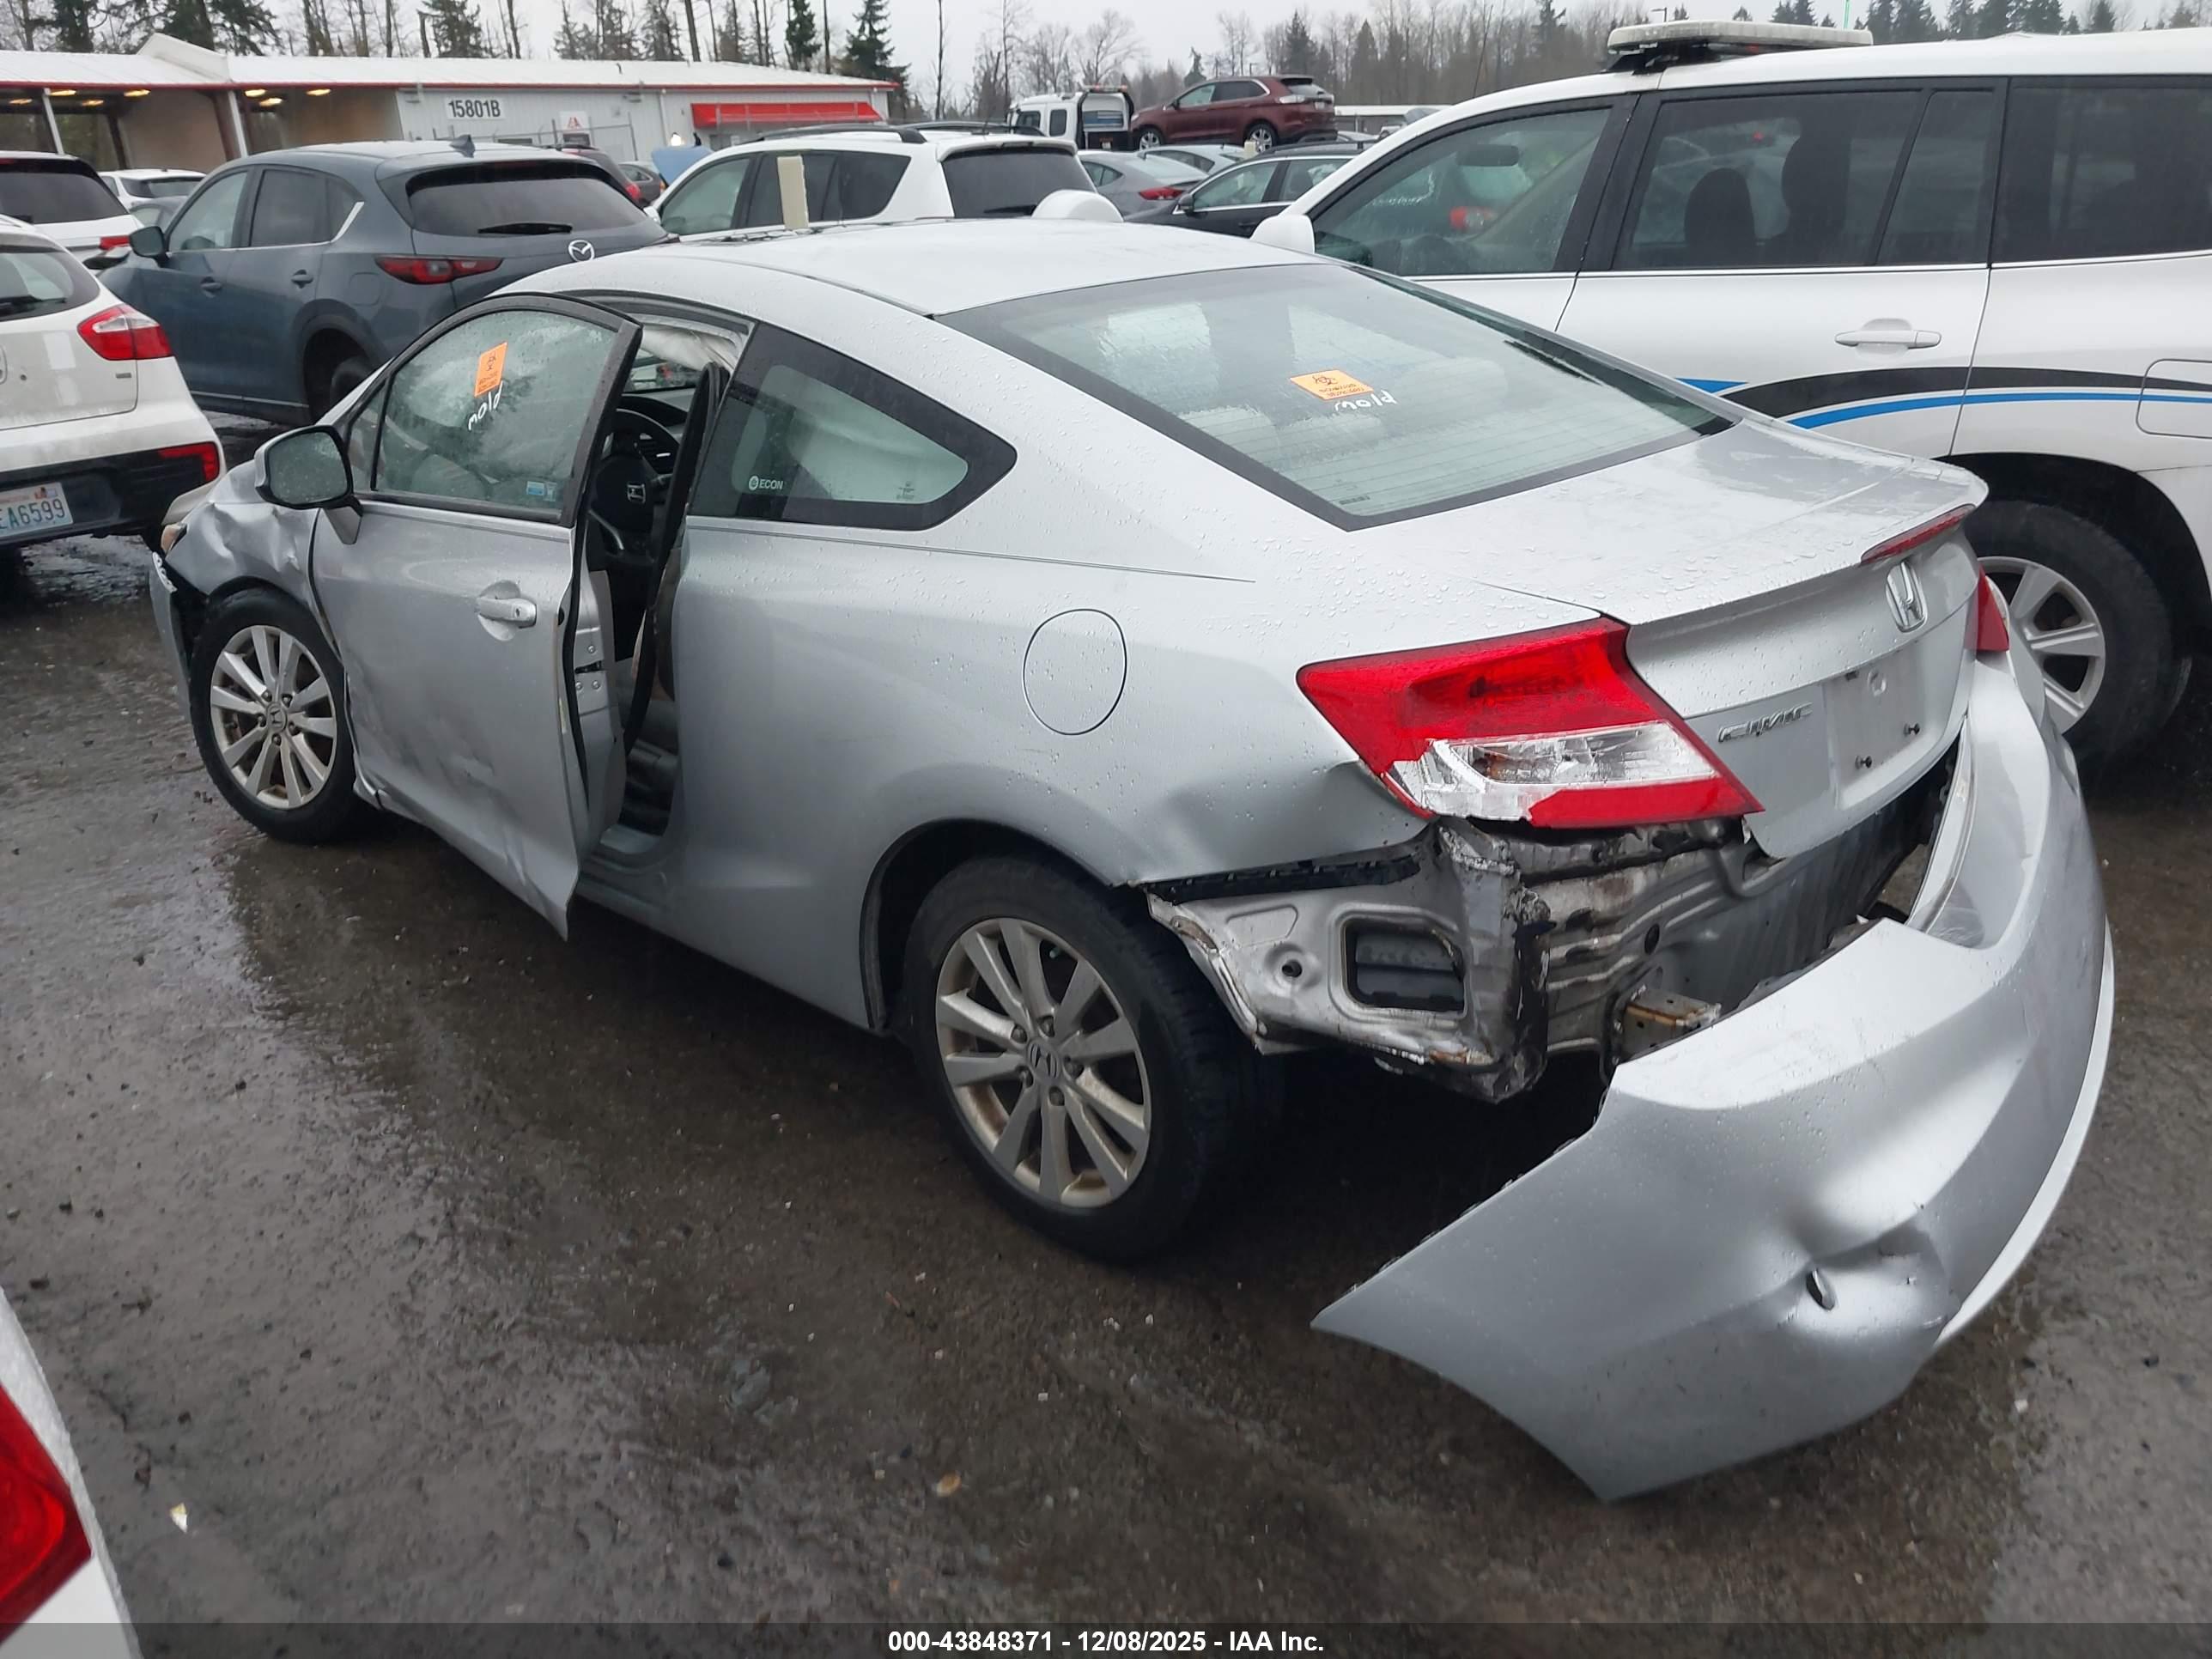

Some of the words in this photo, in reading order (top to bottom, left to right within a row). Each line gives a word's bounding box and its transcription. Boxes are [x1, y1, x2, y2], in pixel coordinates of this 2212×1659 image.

[448, 100, 501, 118] 15801B
[468, 380, 503, 431] mold
[1334, 389, 1398, 411] mold
[759, 478, 784, 489] ECON
[1717, 702, 1814, 743] CIVIC
